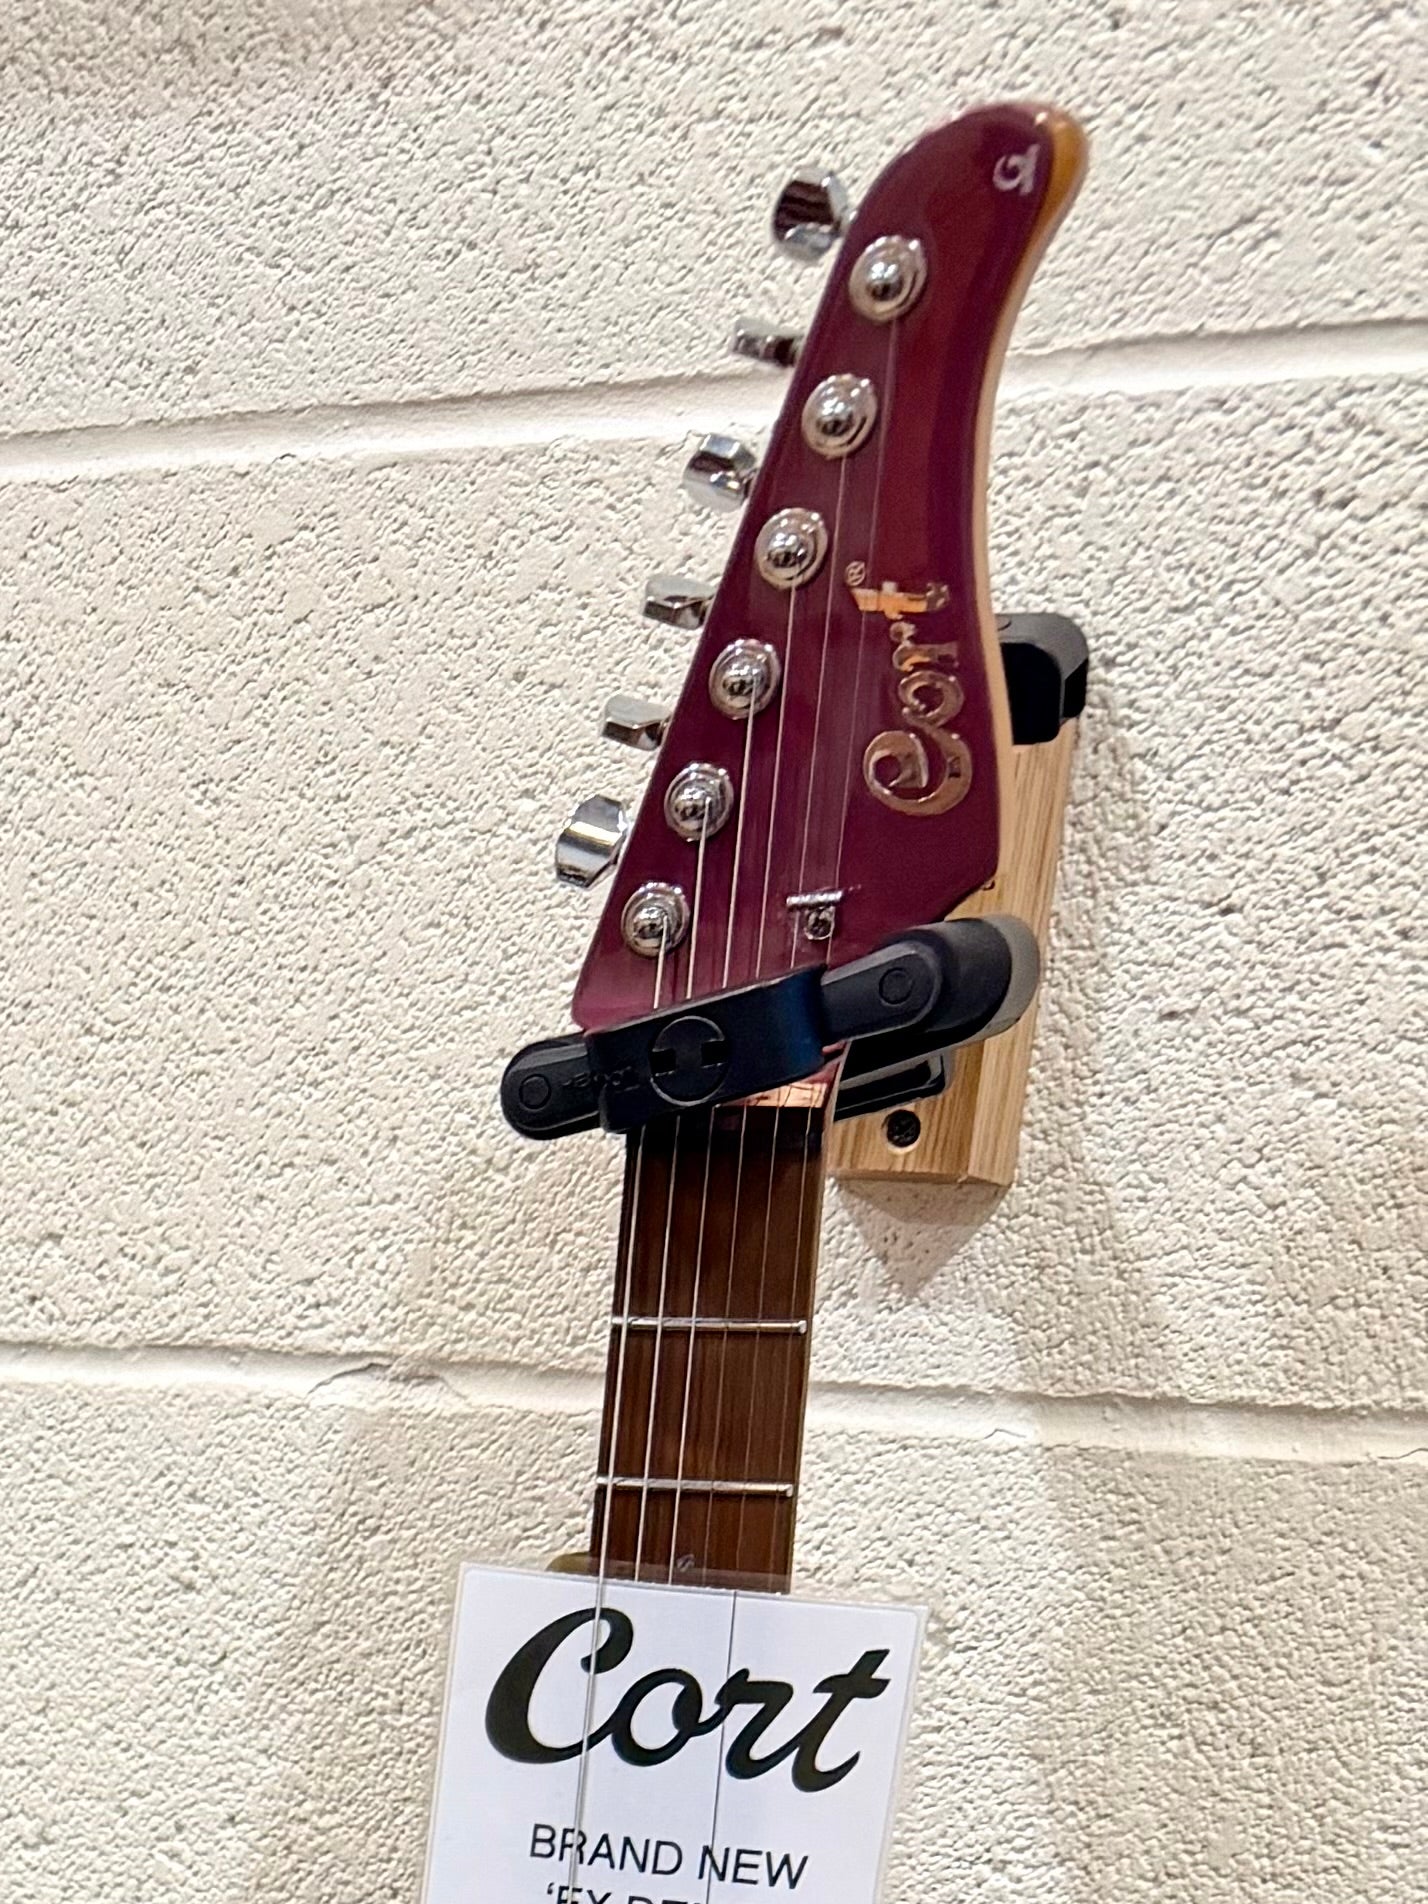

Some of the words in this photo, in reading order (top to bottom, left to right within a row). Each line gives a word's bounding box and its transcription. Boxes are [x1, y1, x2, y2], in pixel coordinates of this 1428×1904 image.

[850, 580, 973, 816] Cort
[484, 1607, 891, 1793] Cort
[529, 1823, 683, 1878] BRAND
[698, 1845, 810, 1890] NEW
